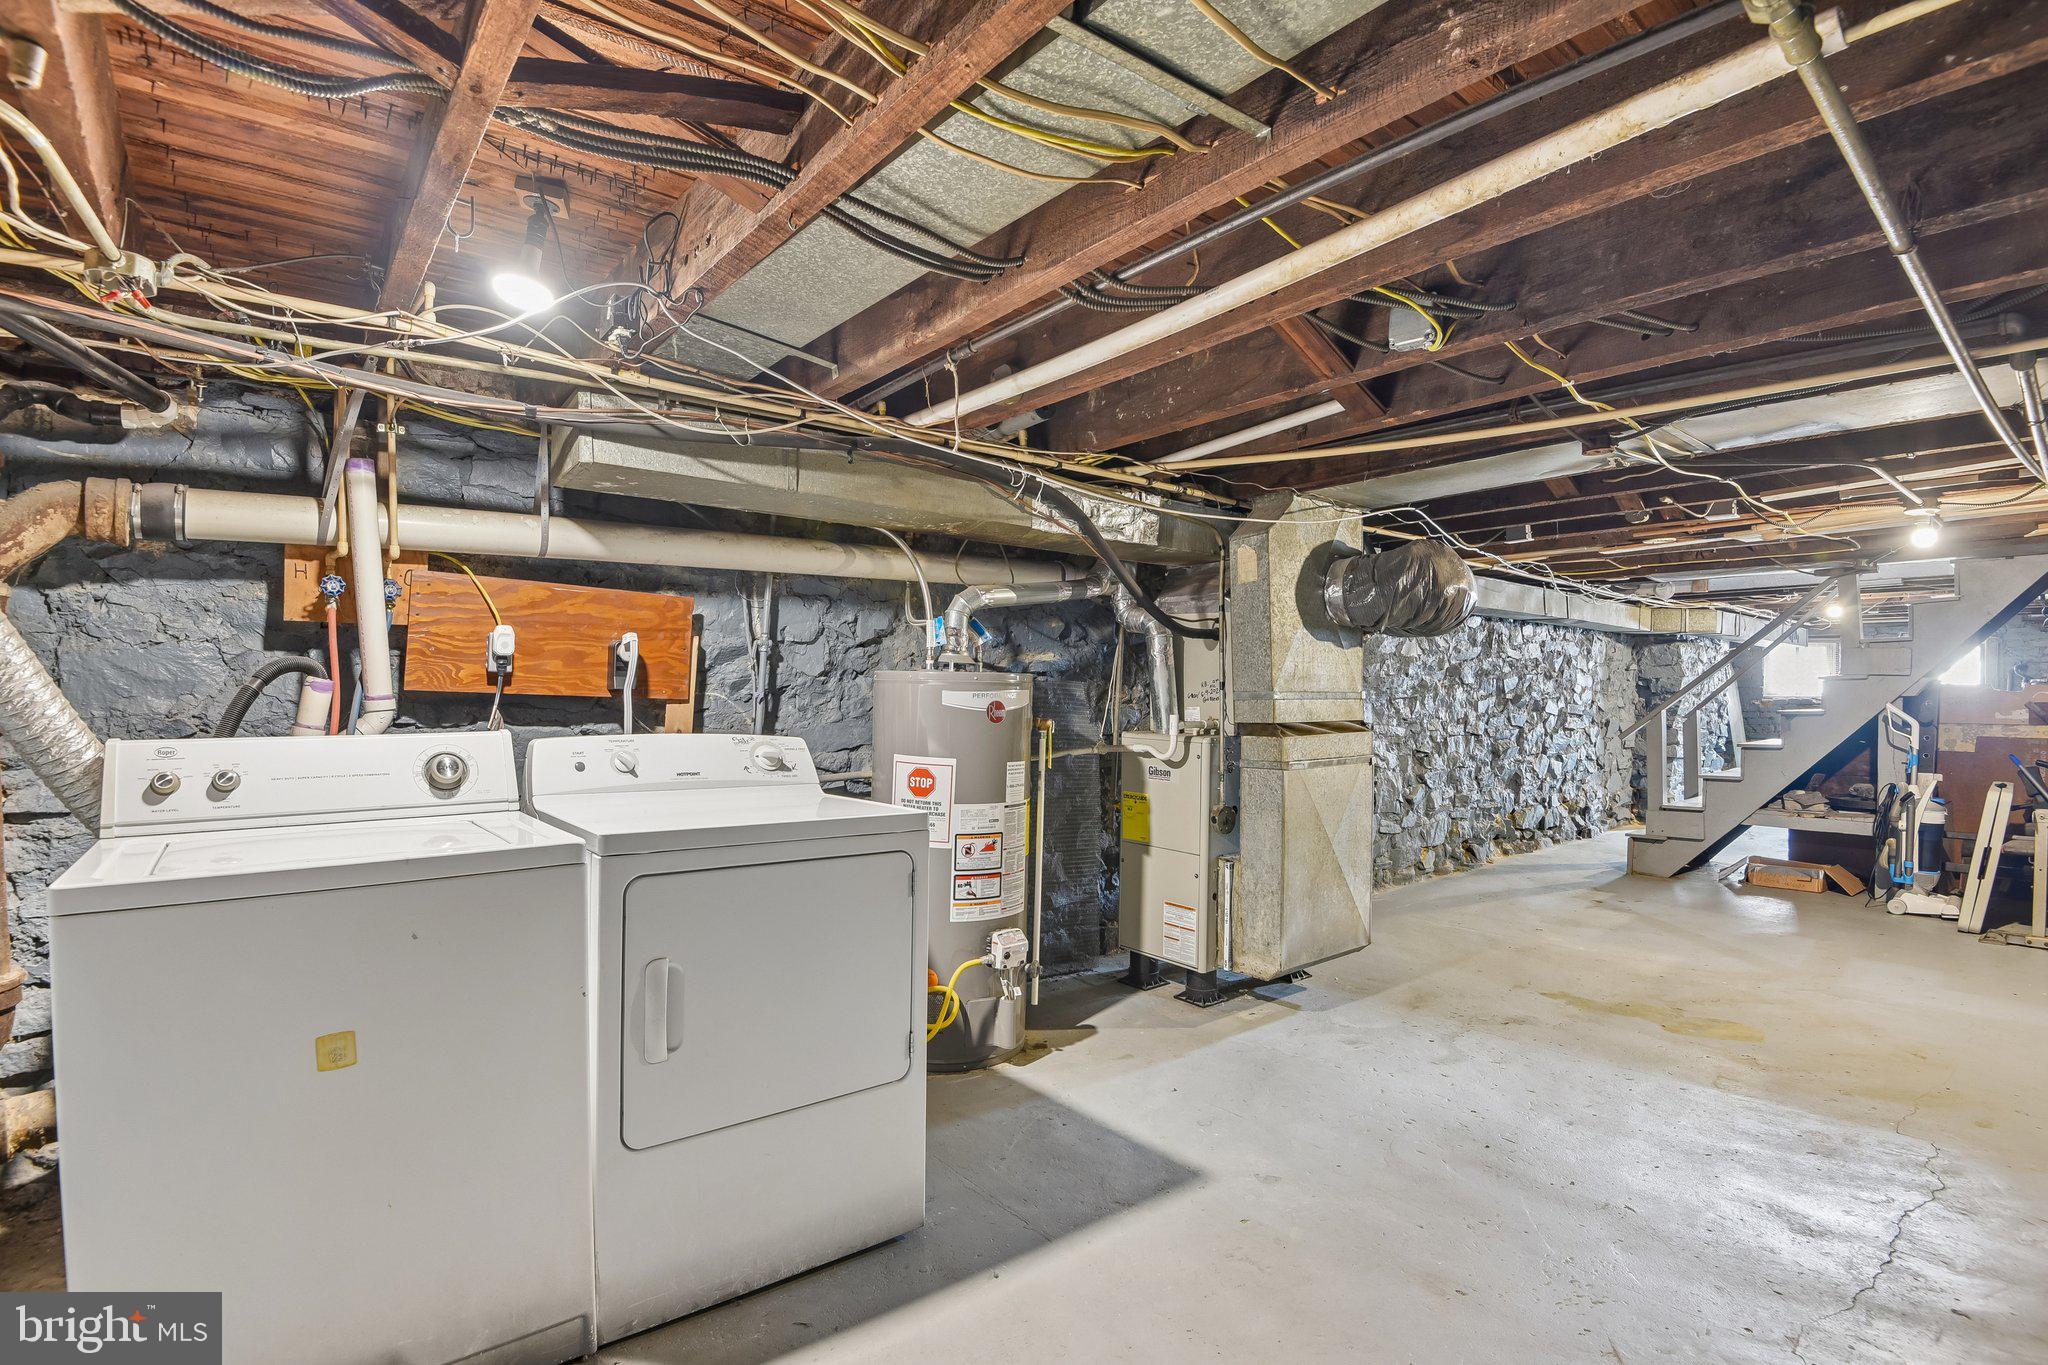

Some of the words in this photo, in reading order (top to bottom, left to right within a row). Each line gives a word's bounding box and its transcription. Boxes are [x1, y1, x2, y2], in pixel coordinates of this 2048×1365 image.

[294, 562, 308, 580] H
[1148, 765, 1171, 778] Gibson
[909, 776, 933, 789] STOP
